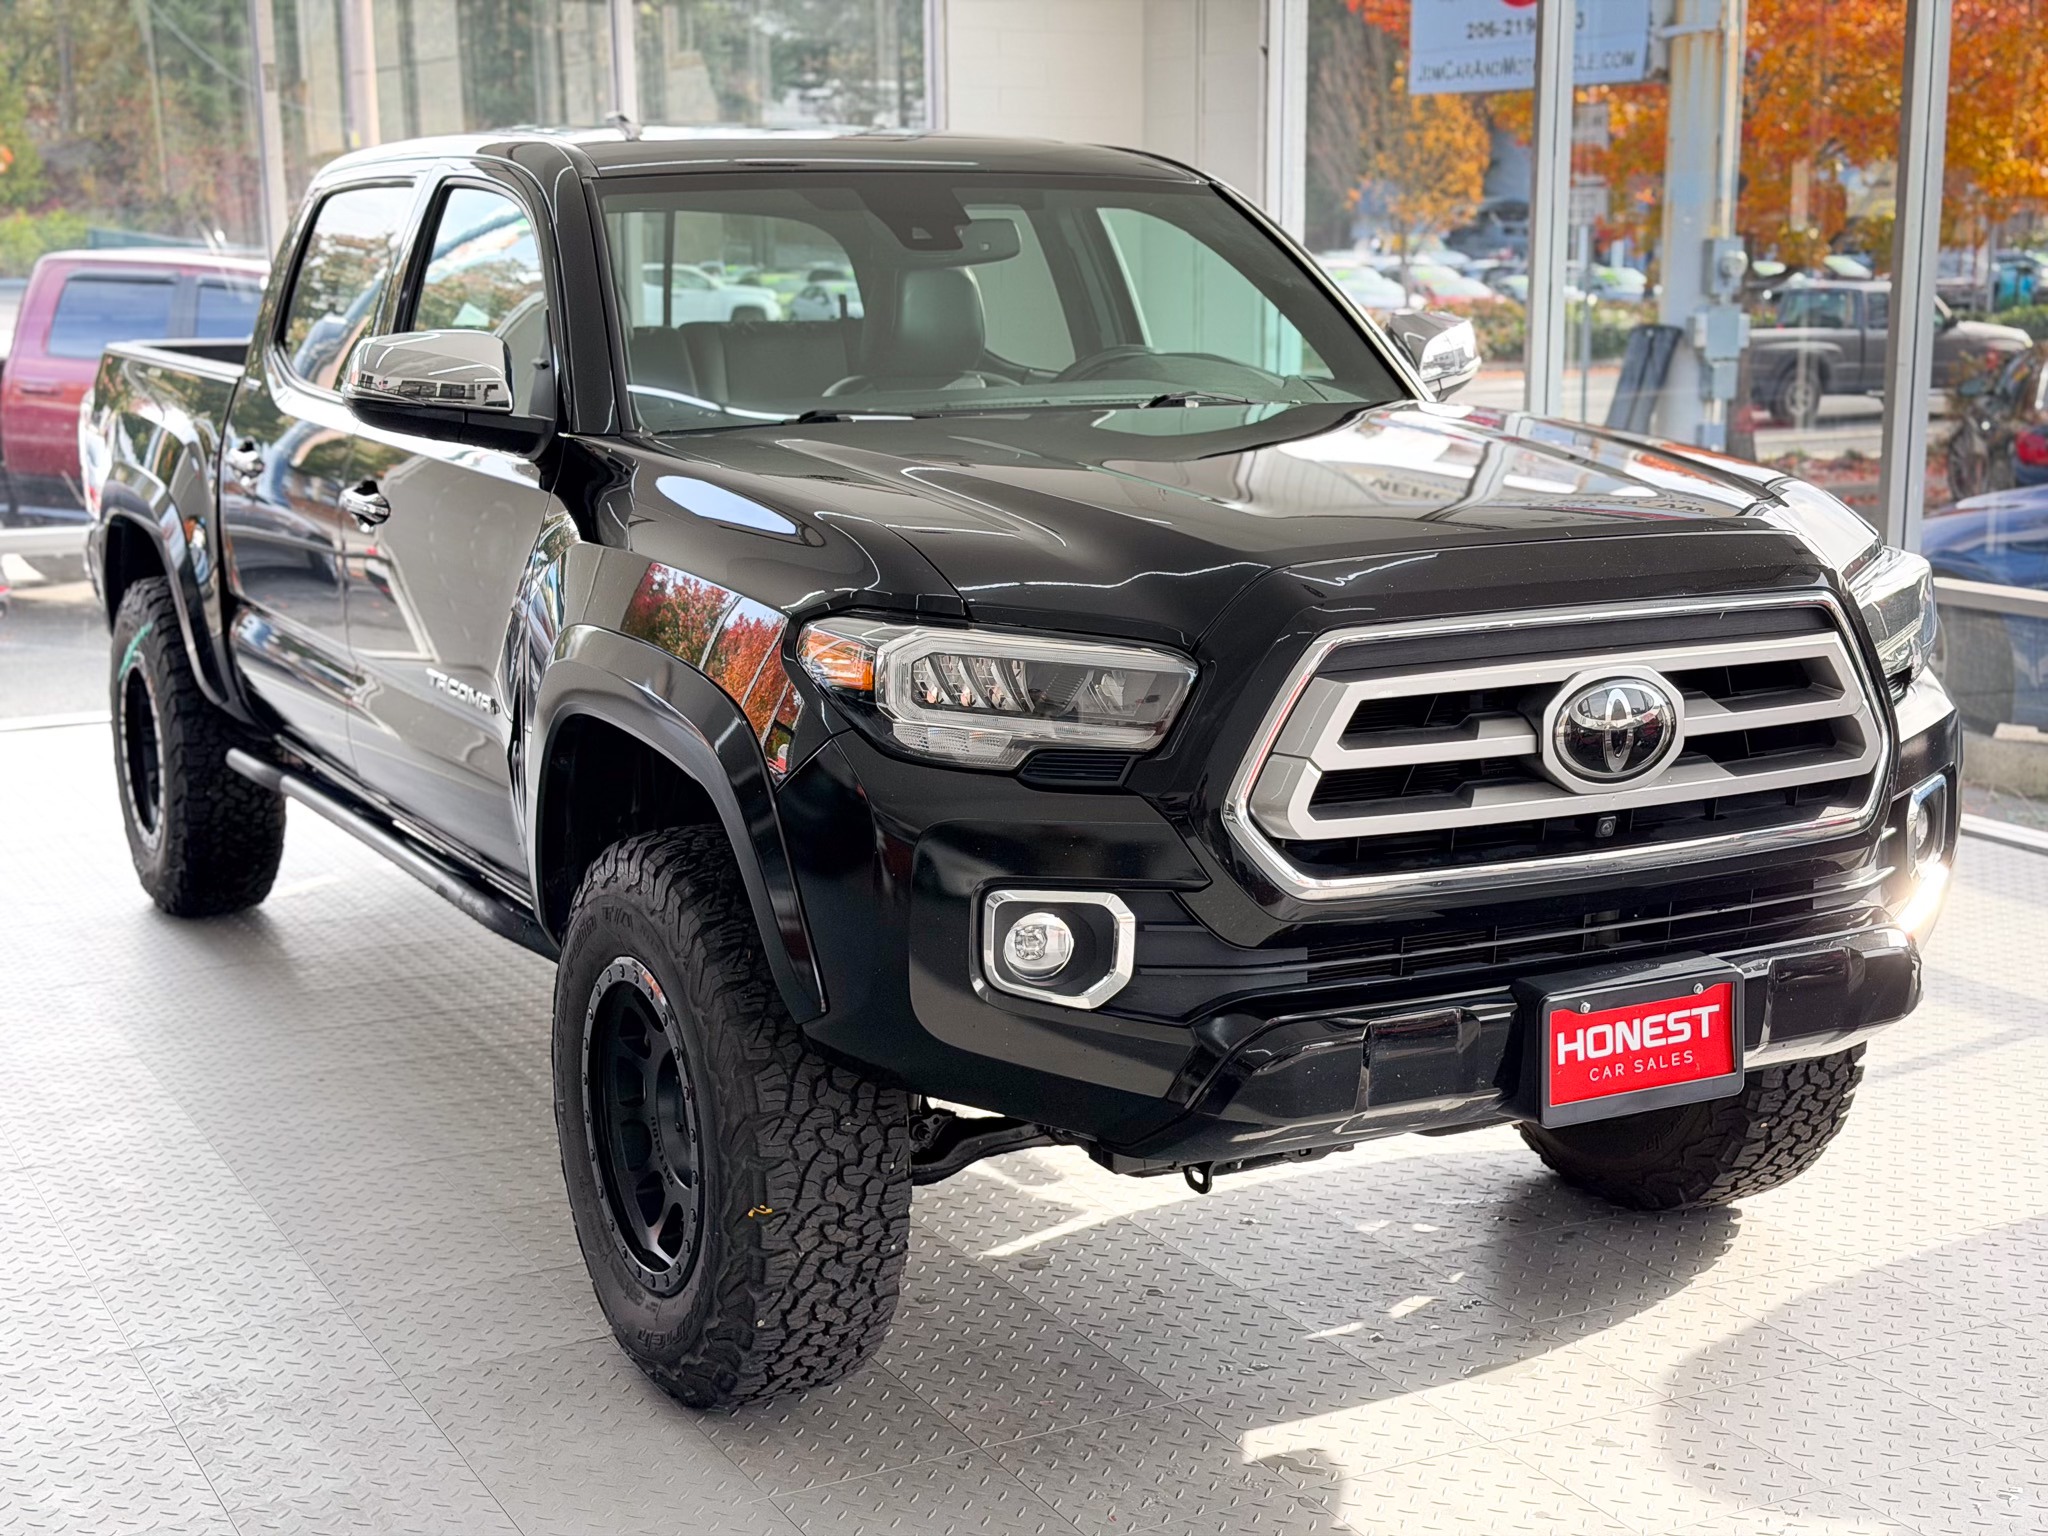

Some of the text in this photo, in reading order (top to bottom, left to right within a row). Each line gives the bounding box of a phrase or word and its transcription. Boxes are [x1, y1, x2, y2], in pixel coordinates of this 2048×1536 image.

[426, 667, 491, 714] TACOMA
[1557, 1004, 1720, 1065] HONEST
[1589, 1050, 1694, 1081] CAR SALES
